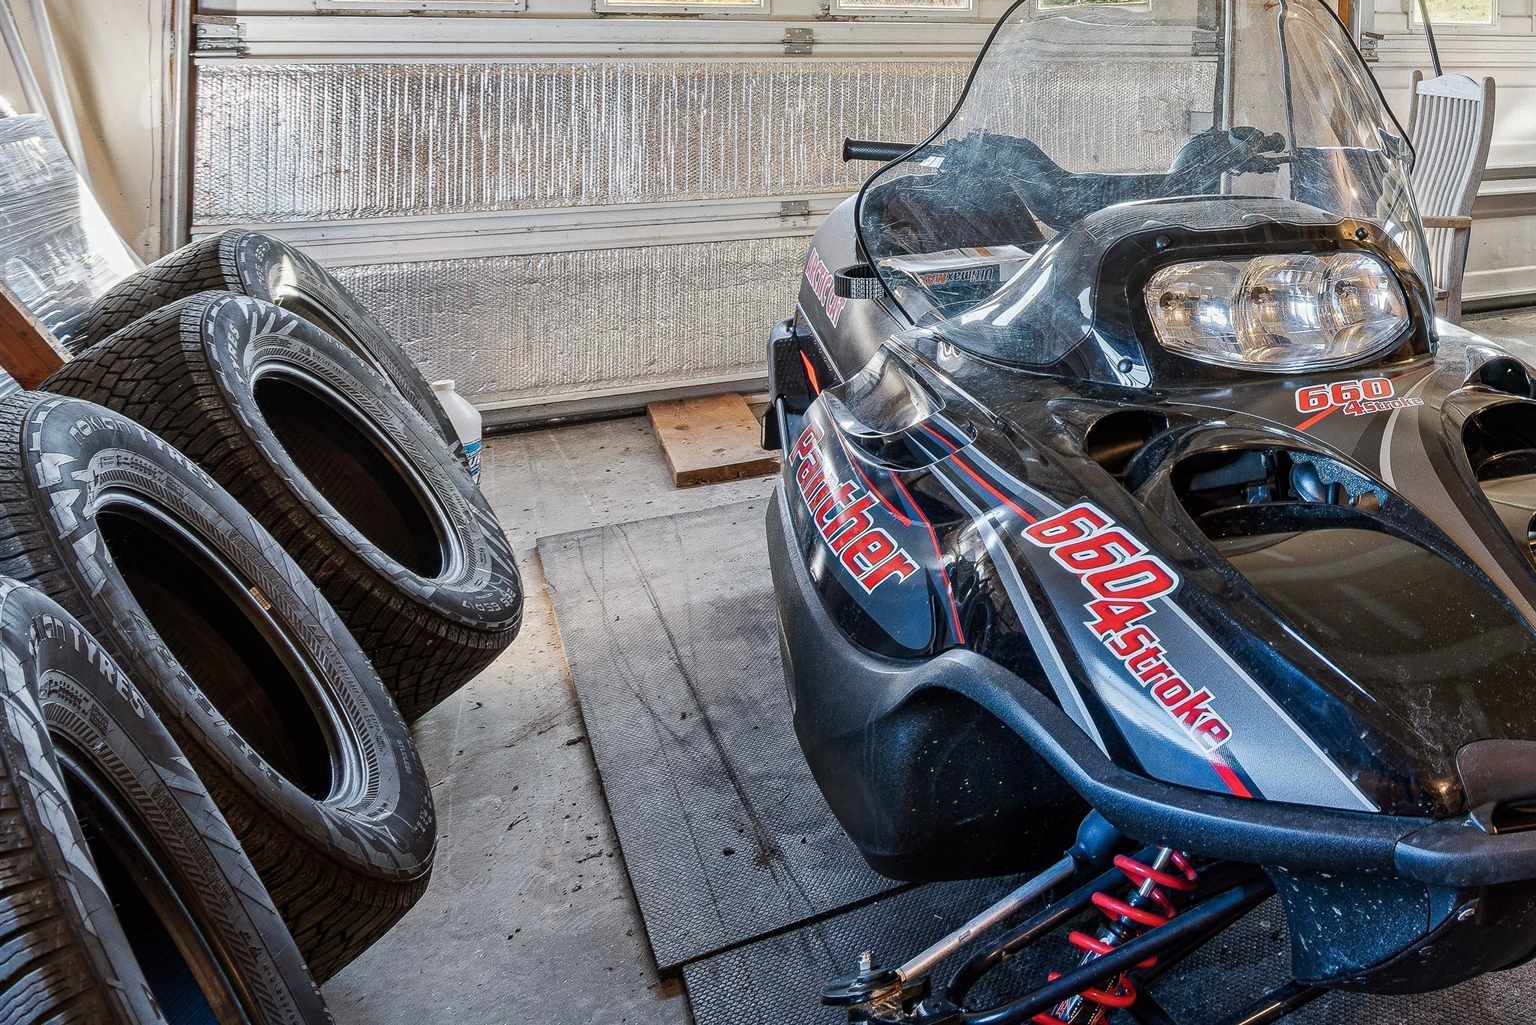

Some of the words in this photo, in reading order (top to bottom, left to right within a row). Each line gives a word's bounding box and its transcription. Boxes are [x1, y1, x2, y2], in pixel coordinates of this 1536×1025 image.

[1295, 377, 1394, 414] 660
[788, 424, 920, 595] Panther
[1020, 502, 1180, 604] 660
[69, 622, 146, 719] TYRES
[1083, 597, 1233, 754] 4stroke
